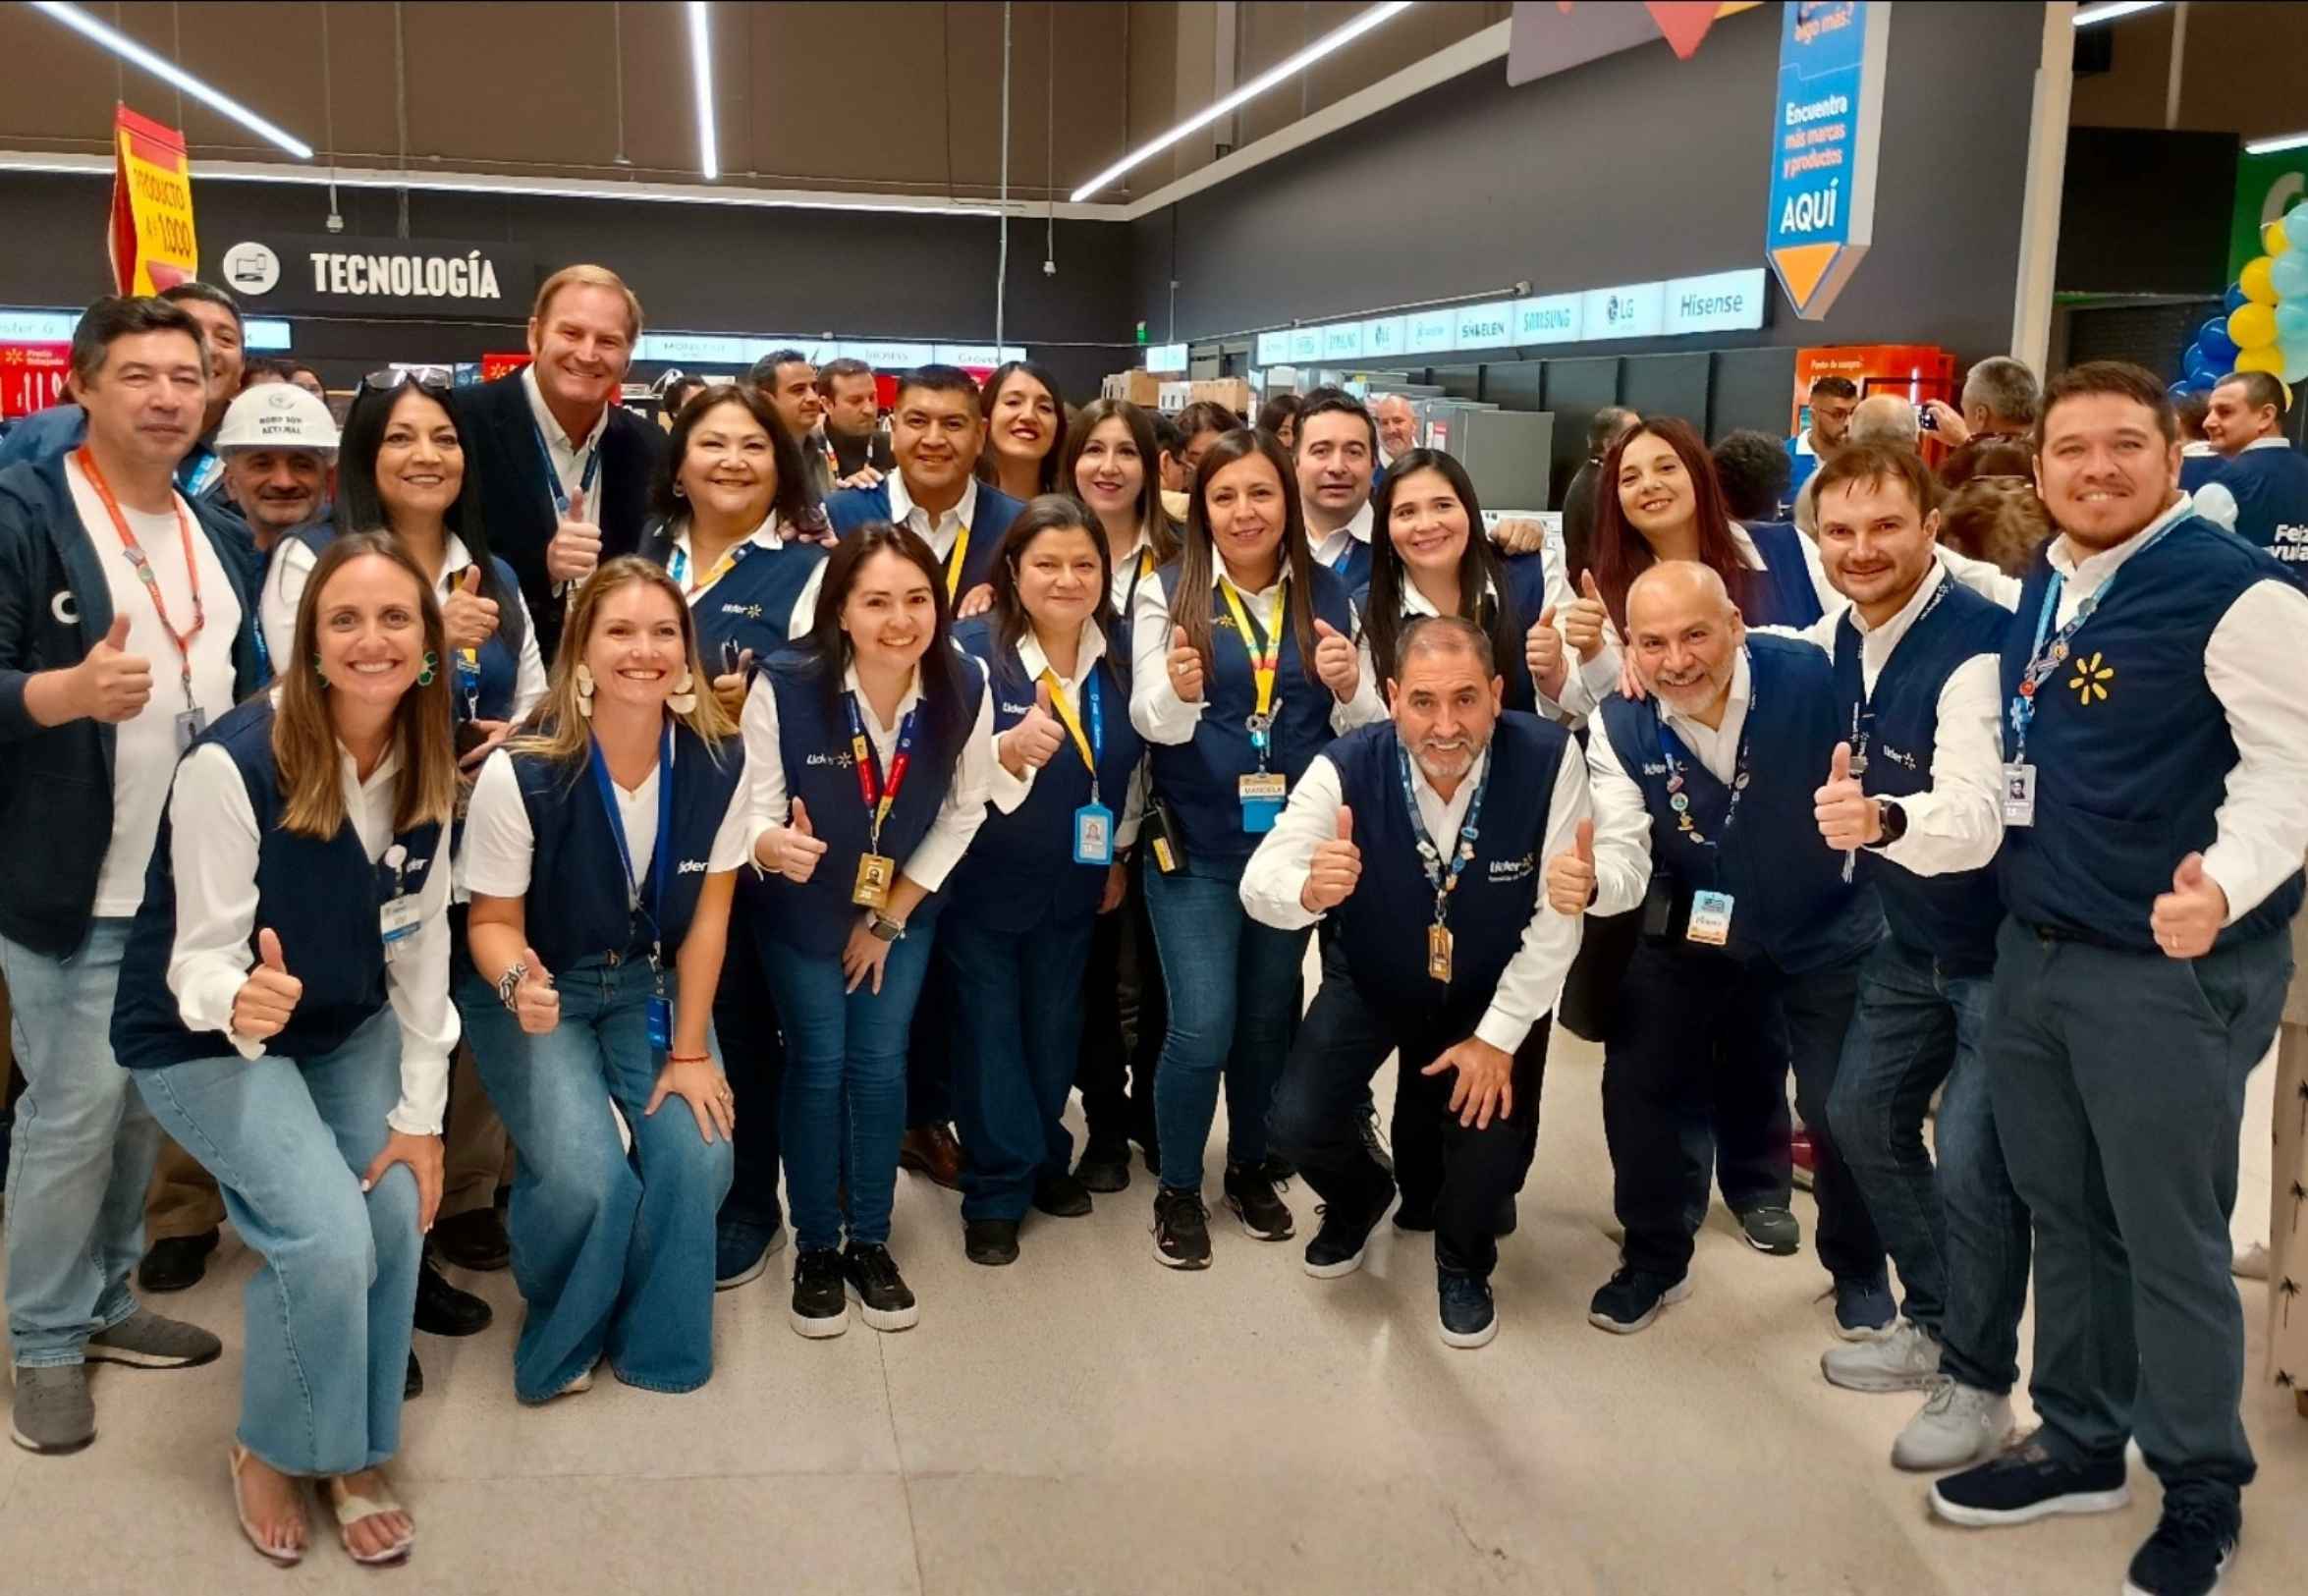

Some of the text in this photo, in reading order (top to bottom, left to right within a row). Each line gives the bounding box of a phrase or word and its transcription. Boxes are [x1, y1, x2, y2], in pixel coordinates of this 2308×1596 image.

[1786, 94, 1848, 126] Encuentra
[1785, 124, 1846, 150] más marcas
[134, 168, 186, 211] PRODUCTO
[1780, 177, 1840, 235] AQUÍ
[309, 249, 501, 299] TECNOLOGÍA
[1523, 308, 1571, 333] SAMSUNG
[1620, 298, 1634, 319] LG
[1680, 294, 1743, 318] Hisense
